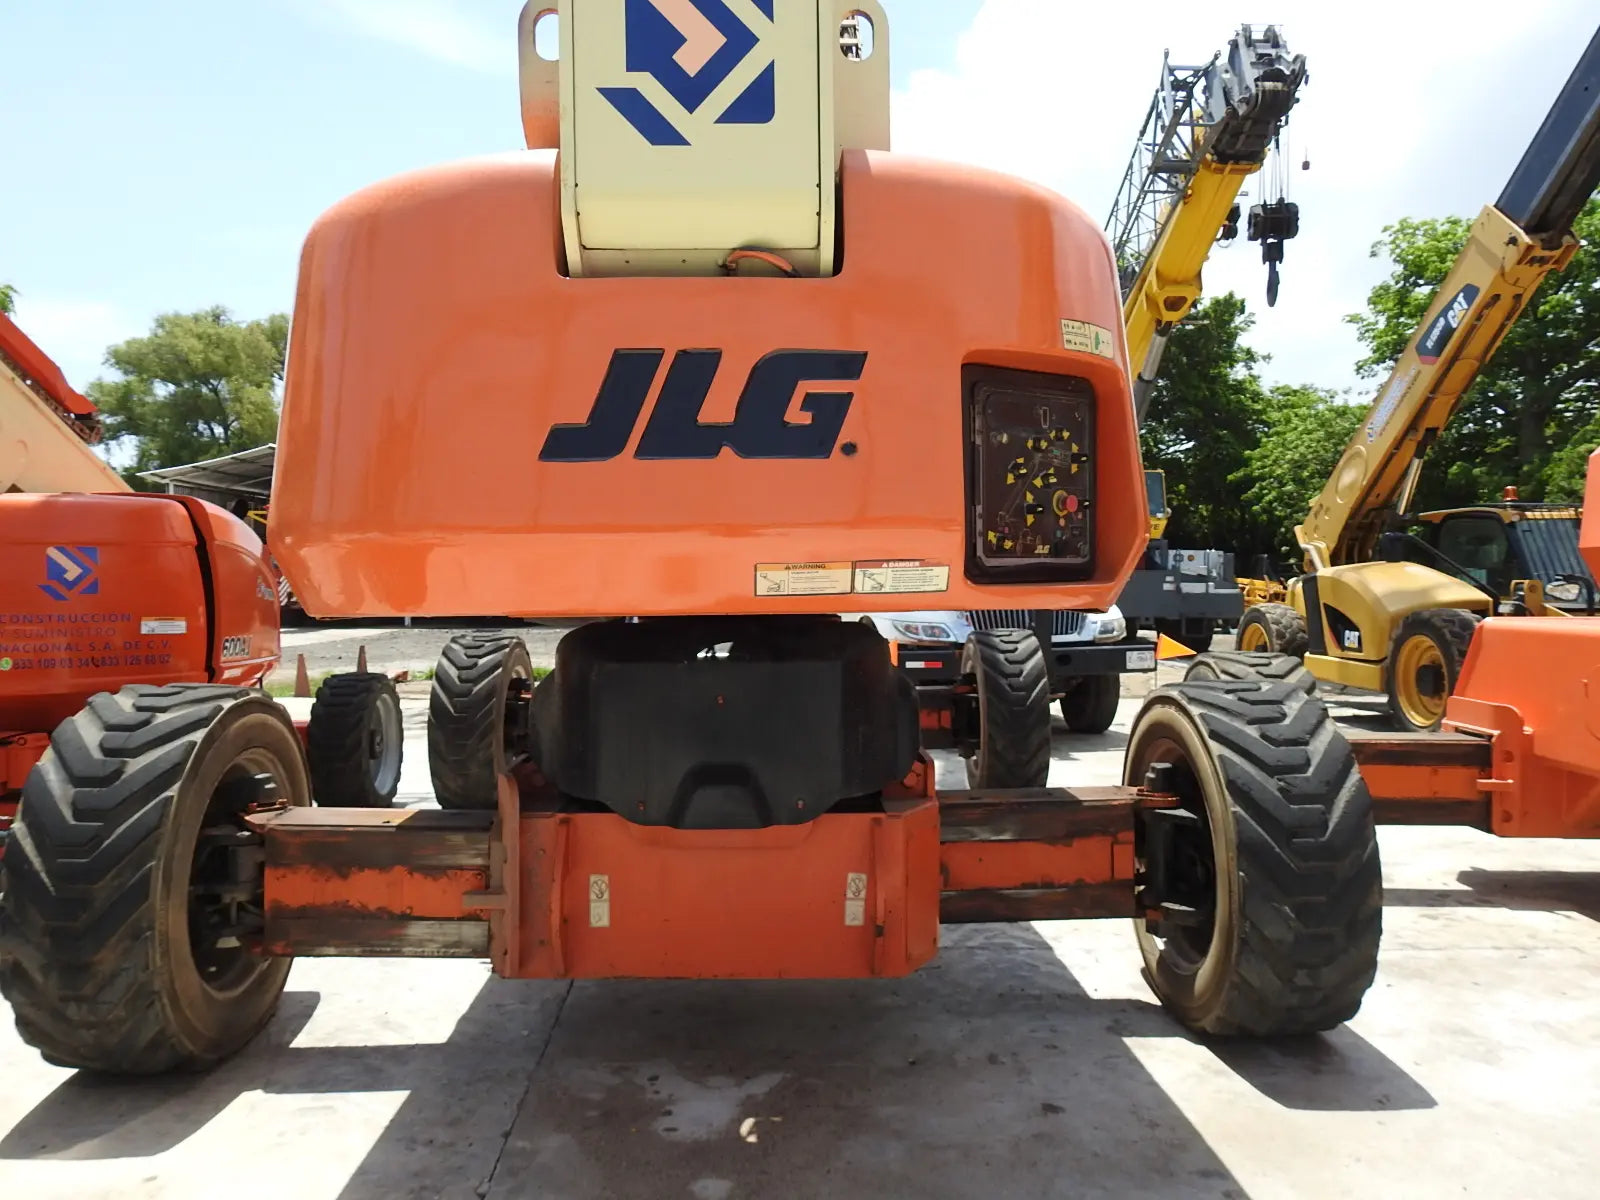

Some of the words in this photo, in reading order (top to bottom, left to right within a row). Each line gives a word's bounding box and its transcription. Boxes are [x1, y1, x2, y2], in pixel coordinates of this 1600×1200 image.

[1447, 292, 1469, 328] CAT
[538, 347, 869, 461] JLG
[888, 560, 921, 569] DANGER
[12, 626, 117, 639] SUMINISTRO
[1344, 629, 1360, 648] CAT
[0, 642, 83, 653] NACIONAL
[124, 640, 141, 650] DE
